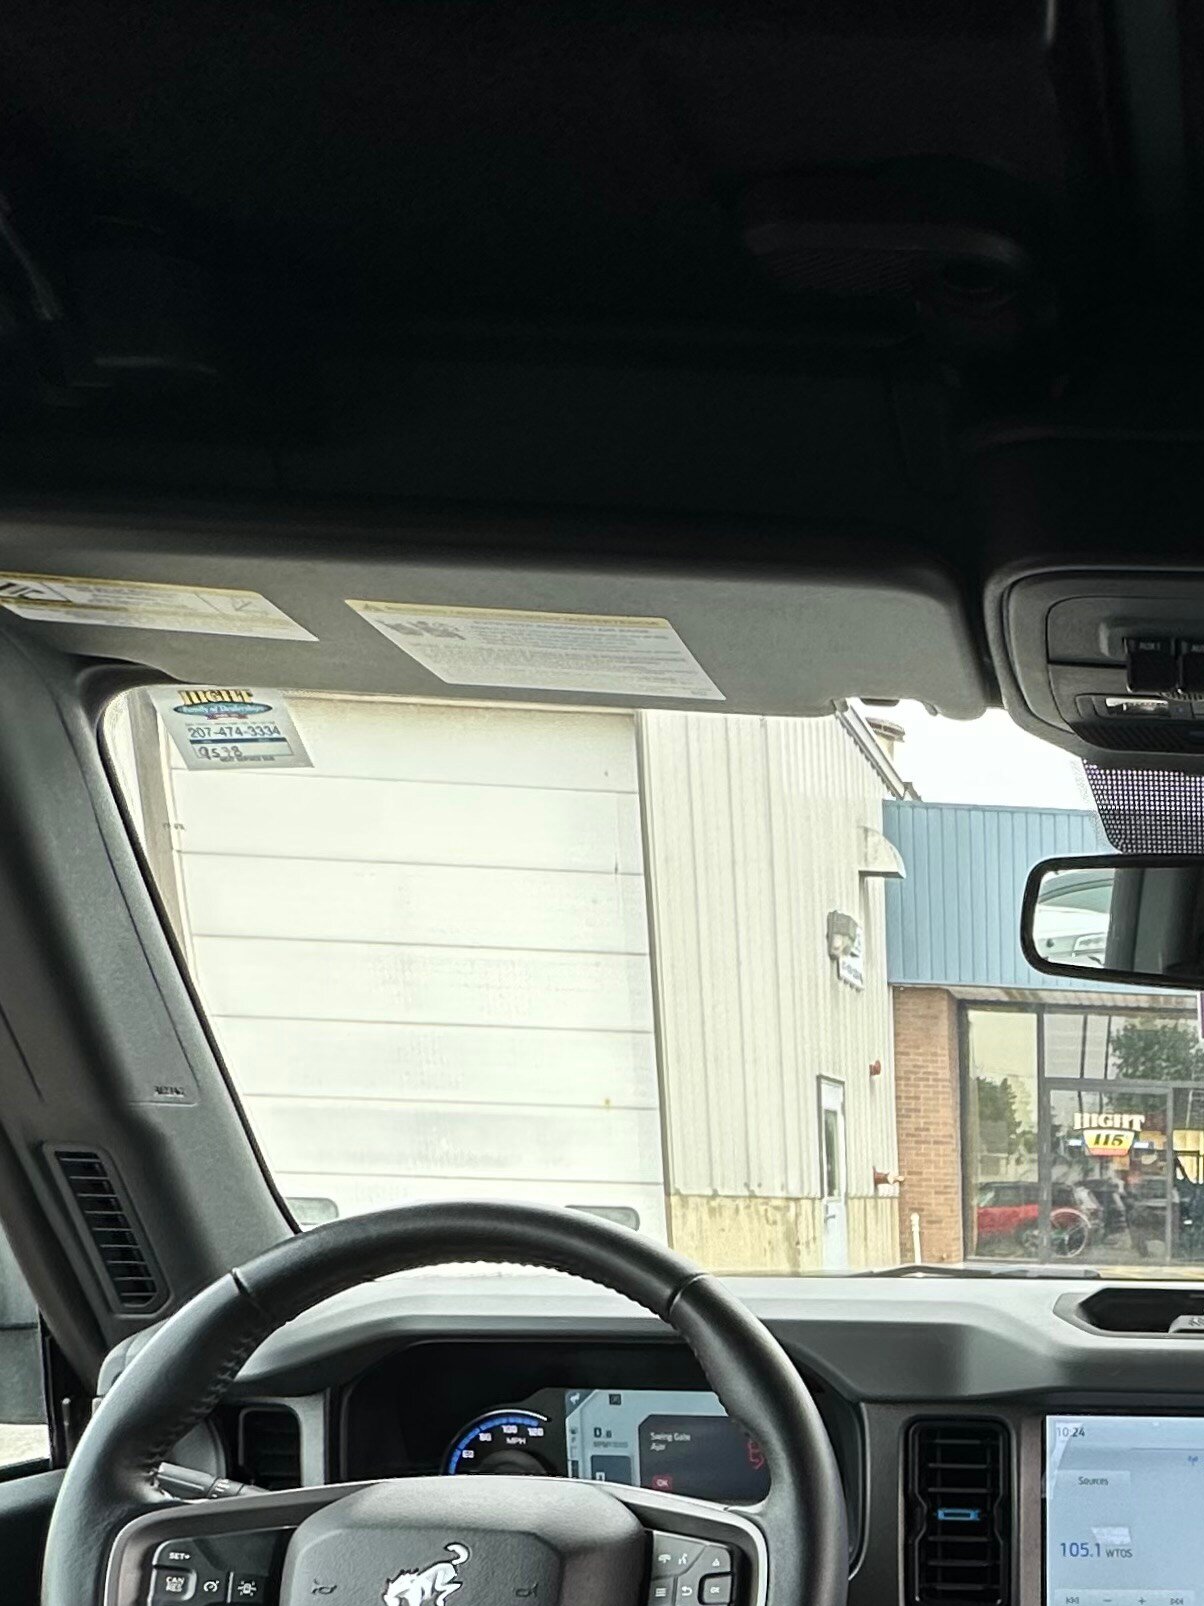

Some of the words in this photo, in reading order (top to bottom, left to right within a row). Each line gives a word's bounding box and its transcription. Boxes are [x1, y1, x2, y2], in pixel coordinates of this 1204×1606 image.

[188, 726, 281, 738] 207-474-3334
[1057, 1427, 1085, 1438] 10:24
[1078, 1476, 1109, 1486] Sources
[1060, 1542, 1101, 1558] 105.1
